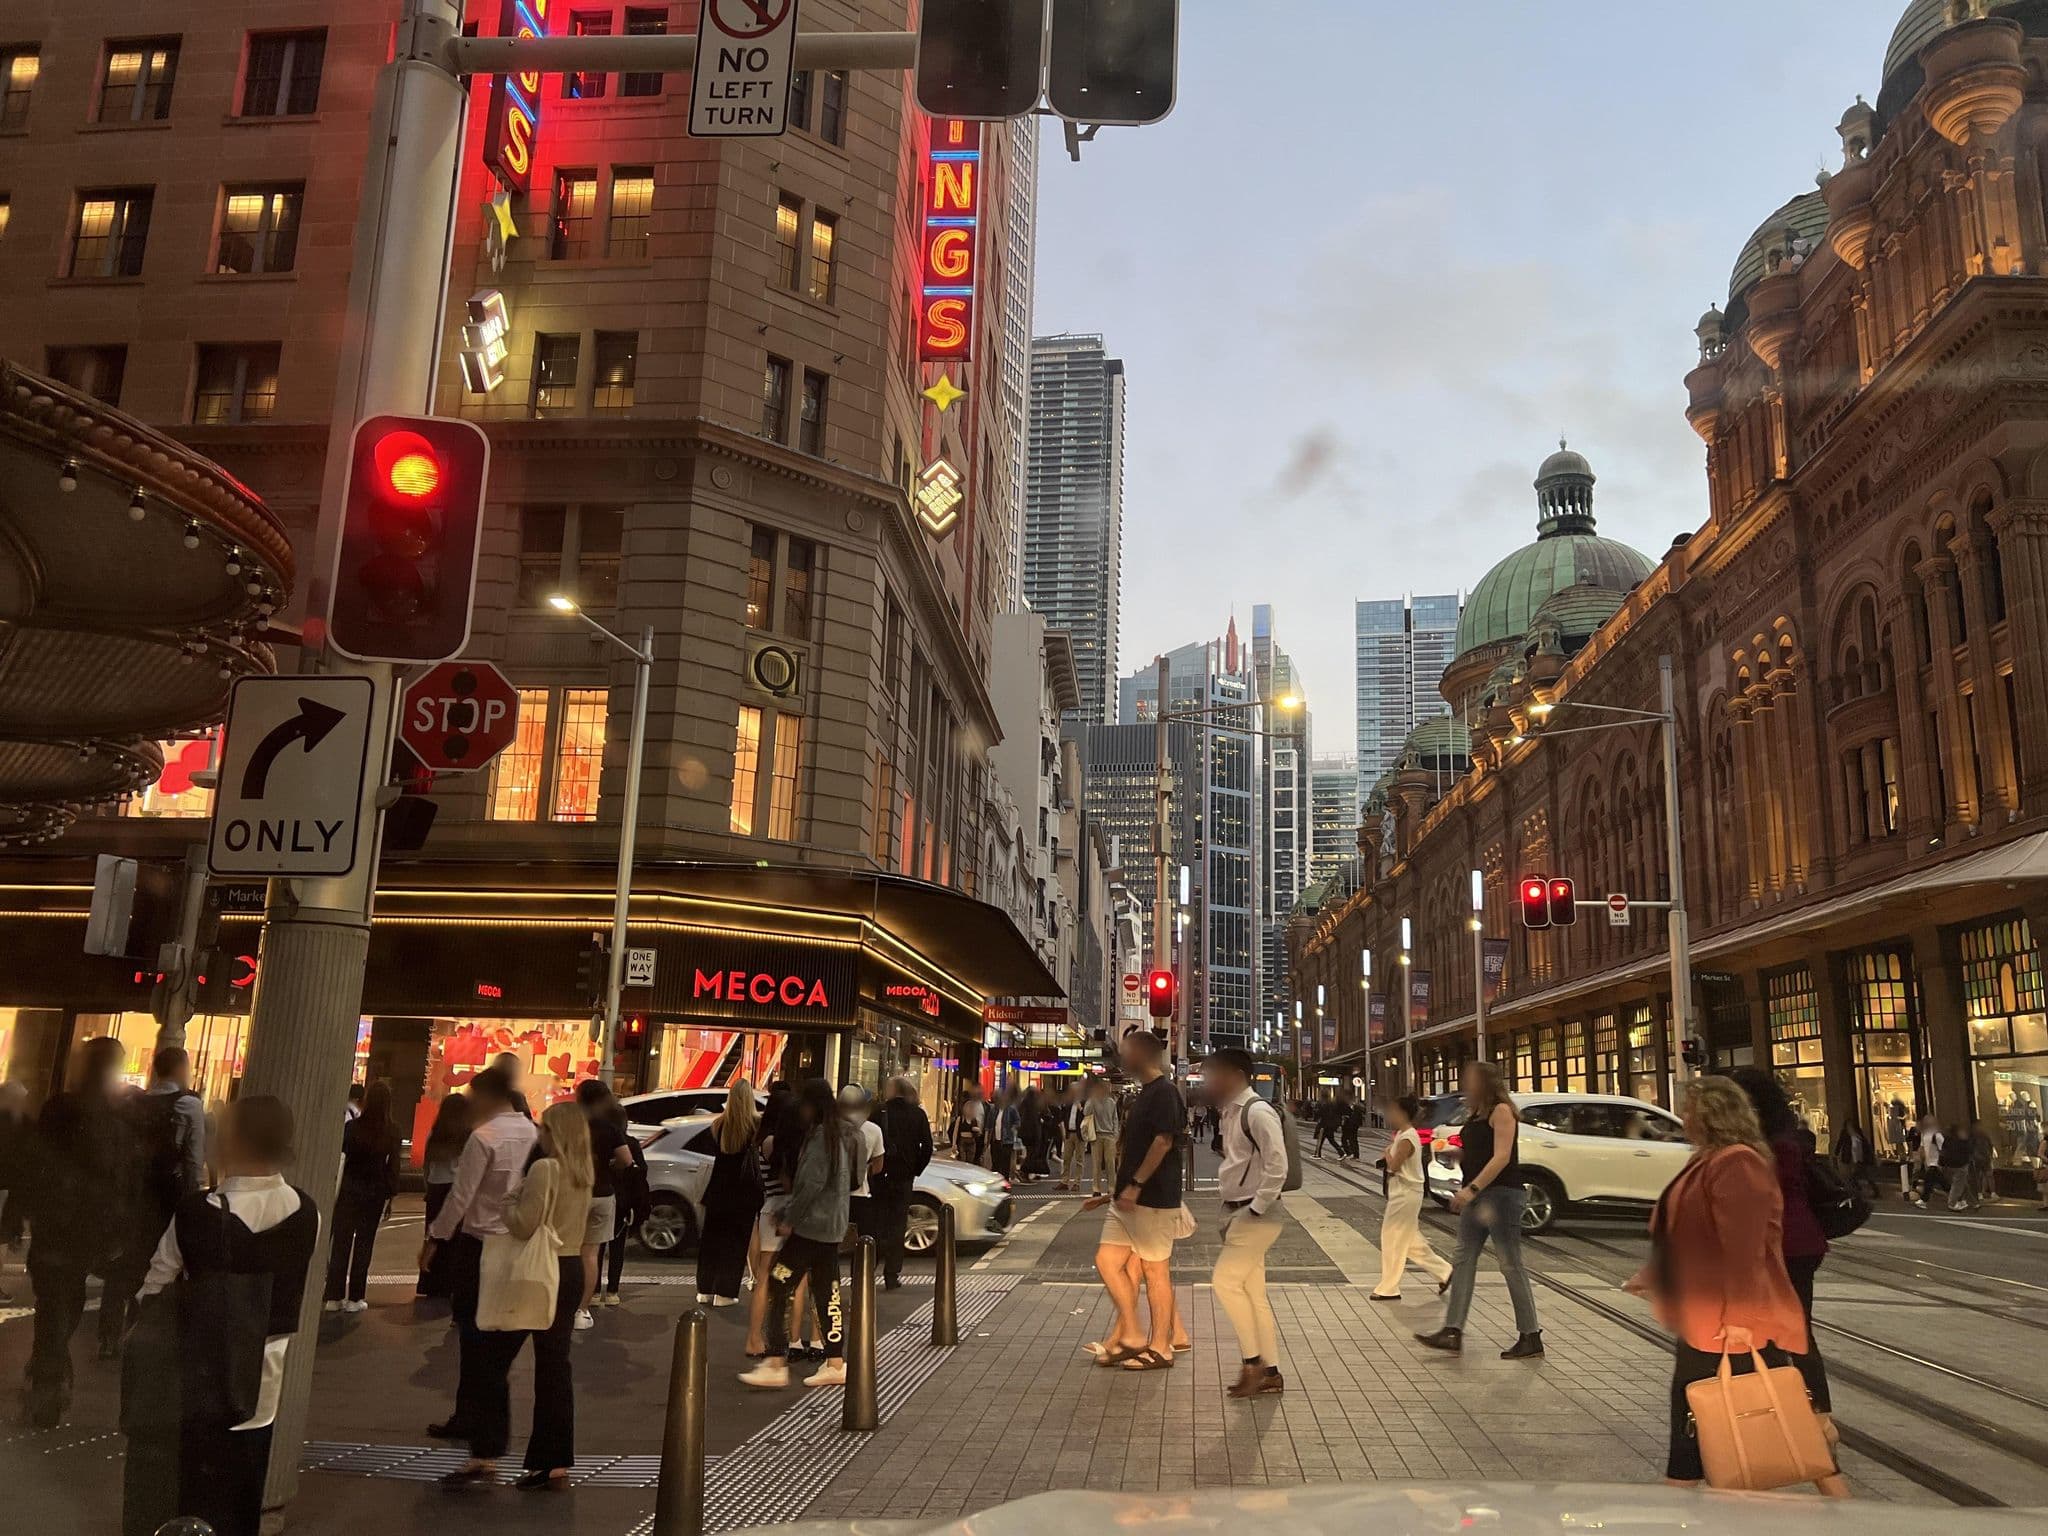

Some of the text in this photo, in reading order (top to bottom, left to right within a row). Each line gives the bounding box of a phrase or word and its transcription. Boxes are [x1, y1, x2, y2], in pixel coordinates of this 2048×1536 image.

[718, 47, 769, 73] NO
[709, 81, 773, 99] LEFT
[705, 107, 773, 125] TURN
[413, 696, 506, 734] STOP
[224, 819, 344, 852] ONLY
[632, 952, 652, 961] ONE
[630, 963, 652, 972] WAY
[478, 984, 502, 998] MECCA
[693, 968, 829, 1007] MECCA
[886, 986, 927, 996] MECCA
[988, 1008, 1024, 1020] Kidstuff
